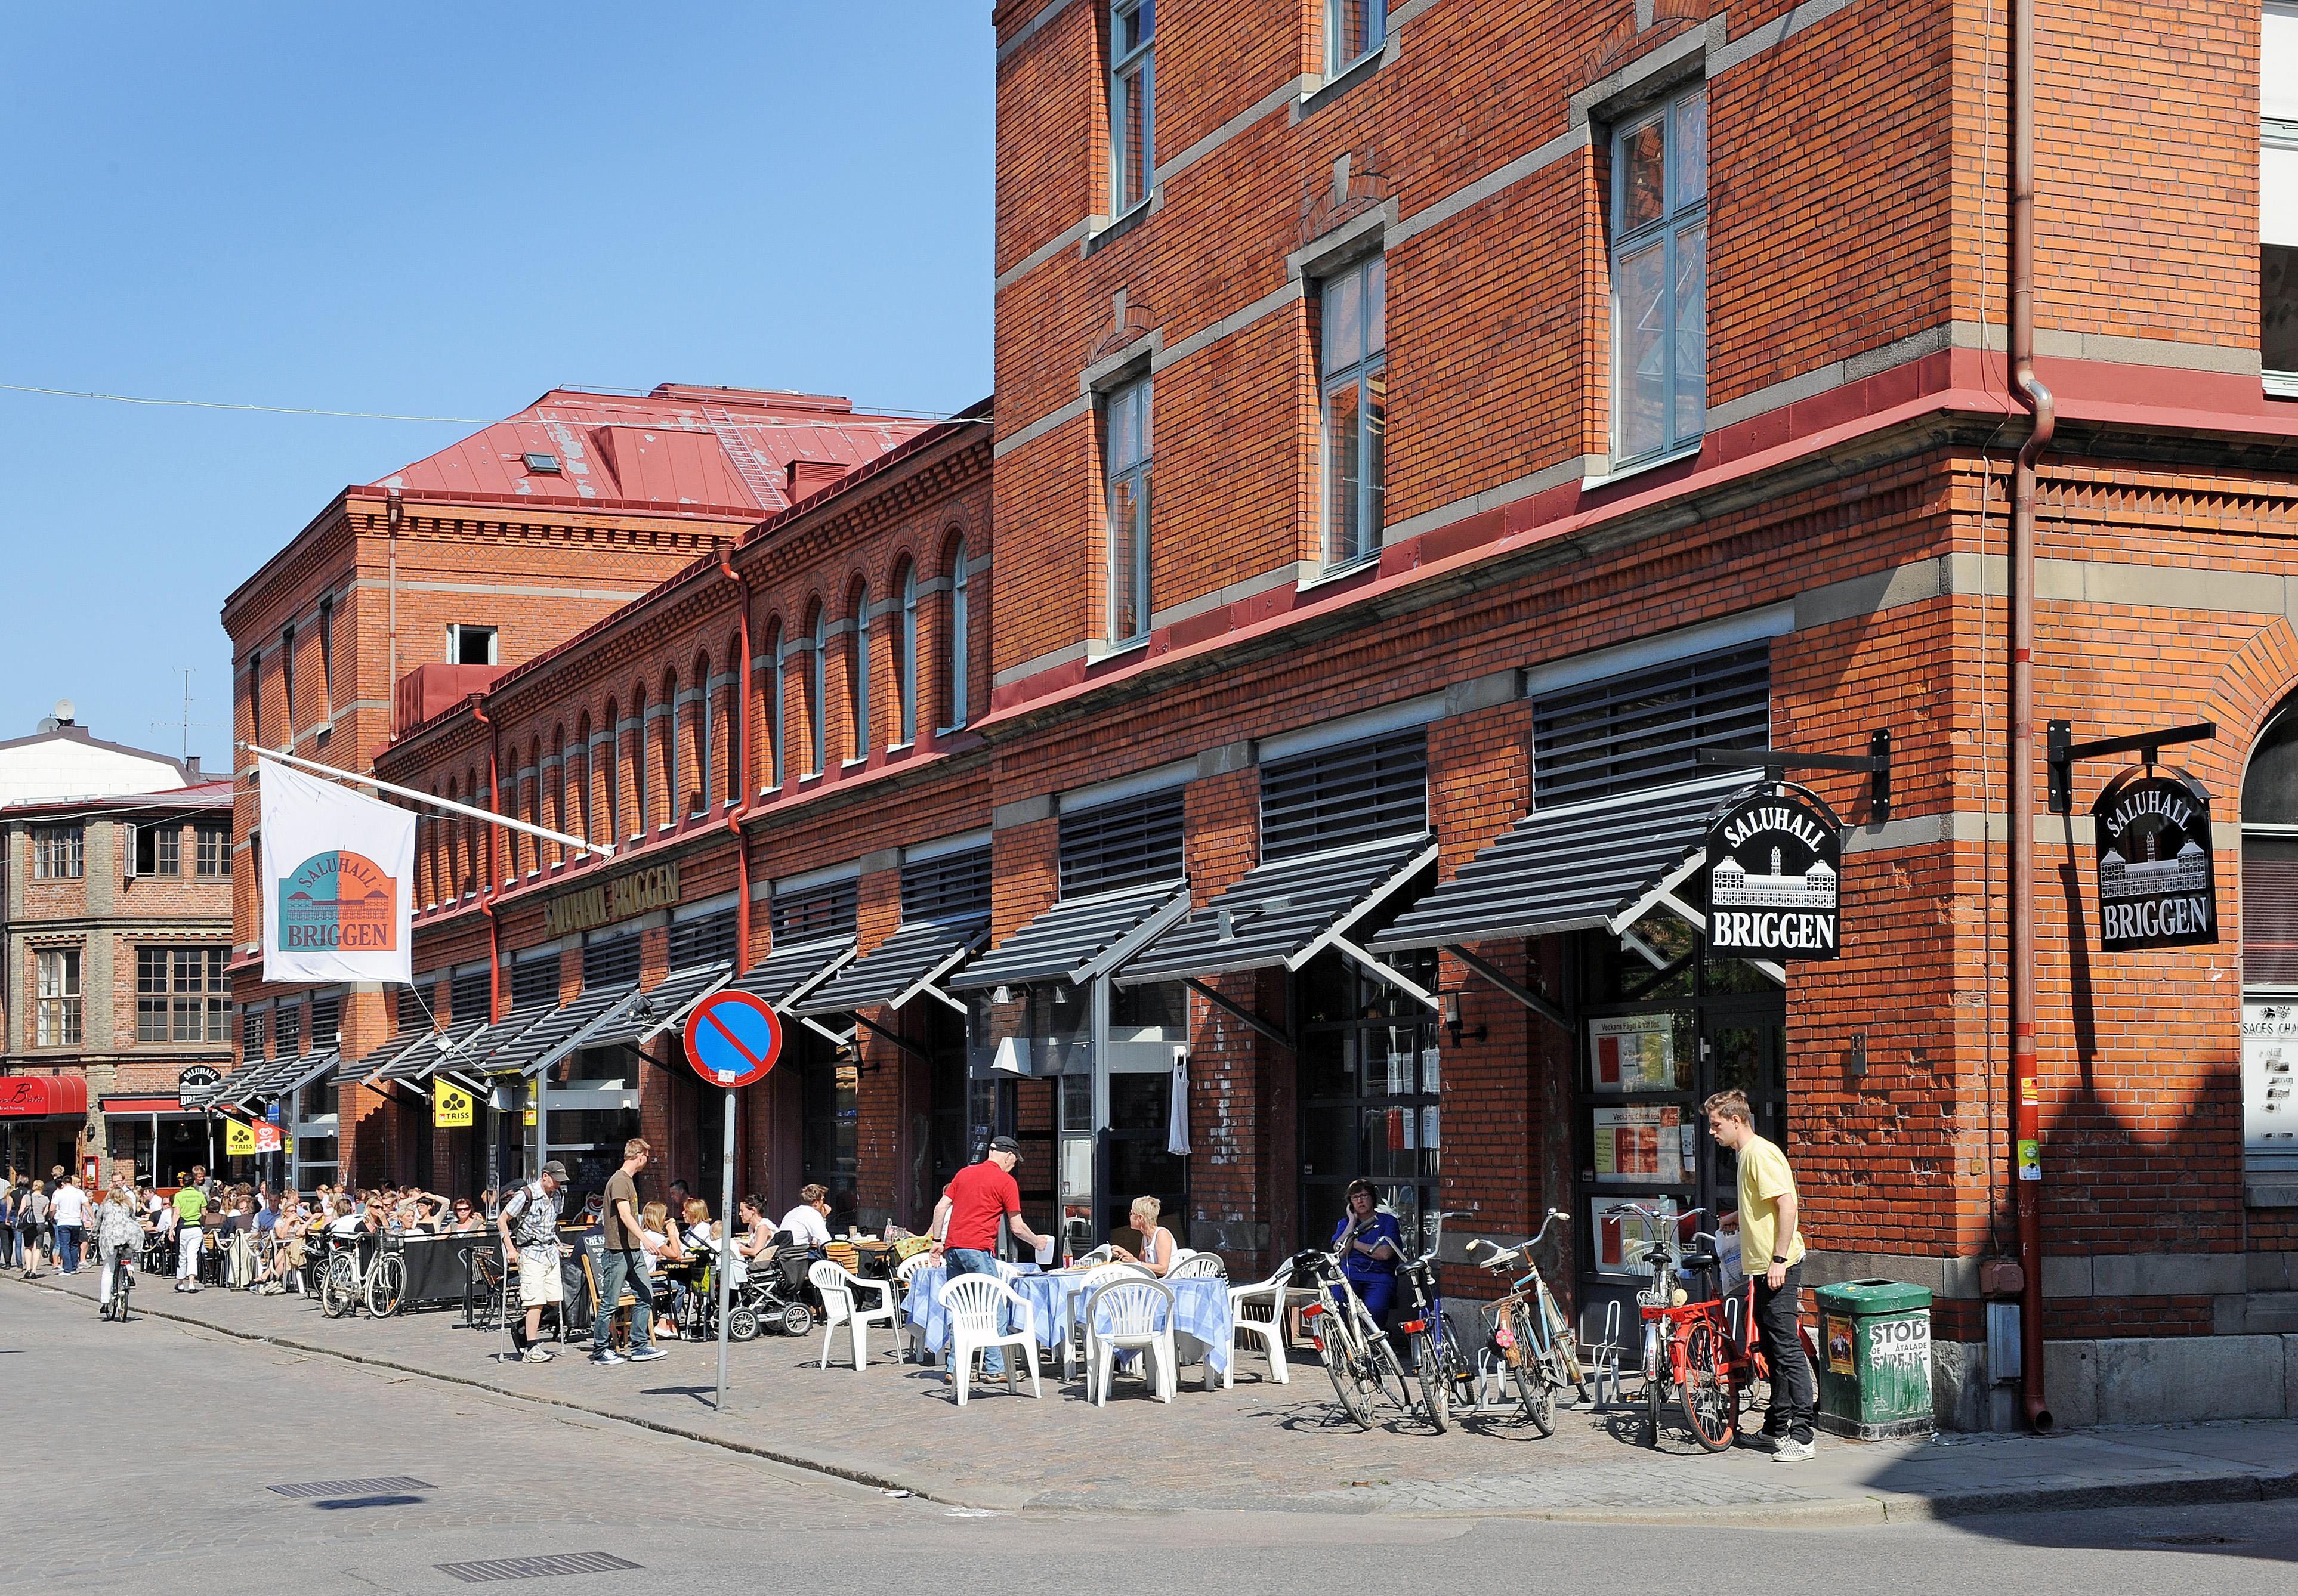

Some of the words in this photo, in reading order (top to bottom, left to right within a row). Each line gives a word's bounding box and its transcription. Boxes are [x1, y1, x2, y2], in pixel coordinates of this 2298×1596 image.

[1724, 807, 1826, 853] SALUHALL
[2106, 791, 2192, 838] SALUHALL
[299, 858, 377, 889] SALUHALL
[611, 862, 680, 918] BRIGGEN
[288, 923, 388, 947] BRIGGEN
[1713, 911, 1836, 949] BRIGGEN
[2103, 896, 2207, 939] BRIGGEN
[183, 1067, 217, 1080] SALUHALL
[1871, 1347, 1881, 1355] DE
[1895, 1342, 1927, 1352] ÅTALADE
